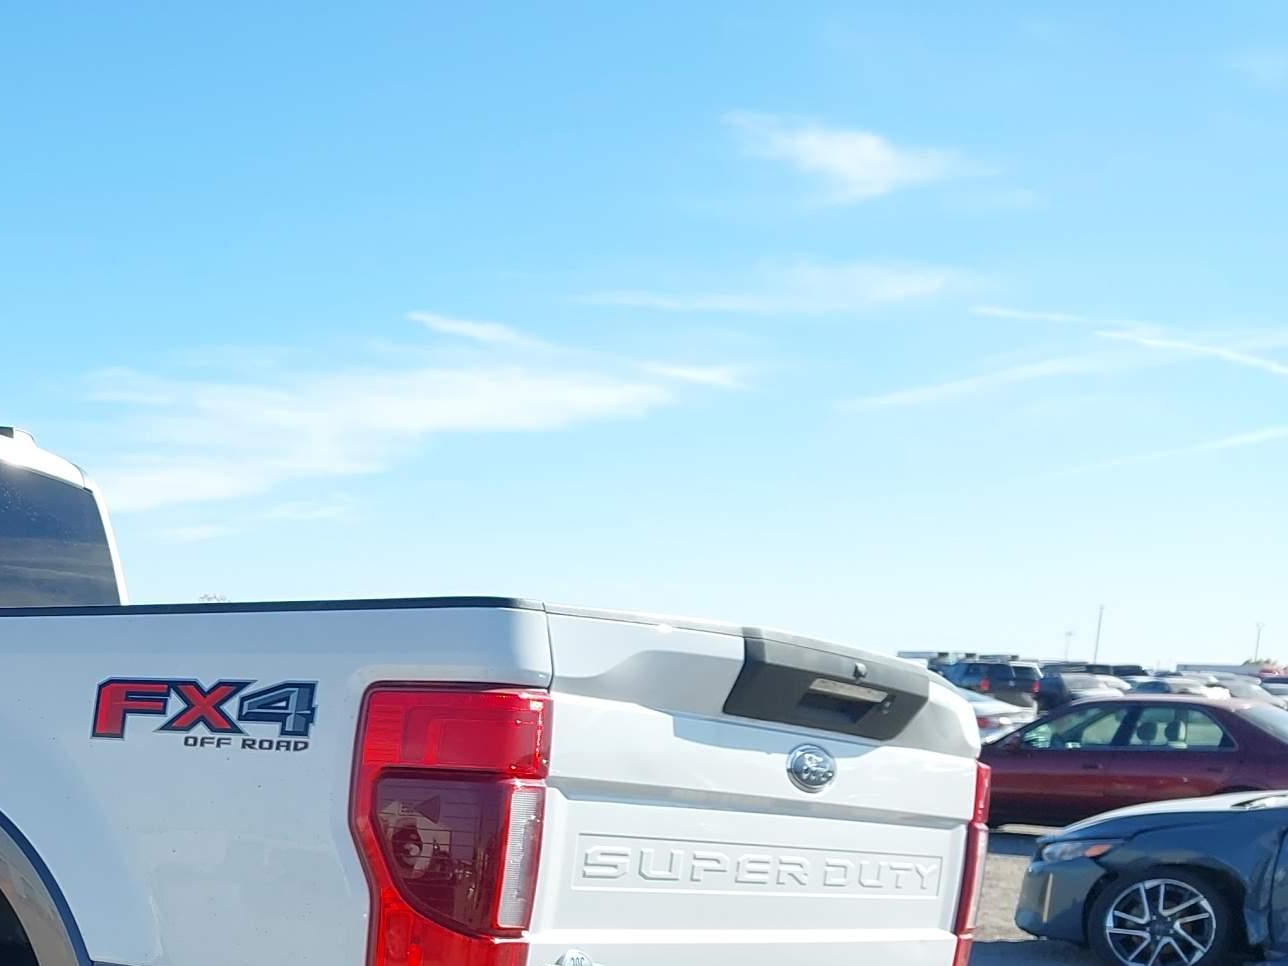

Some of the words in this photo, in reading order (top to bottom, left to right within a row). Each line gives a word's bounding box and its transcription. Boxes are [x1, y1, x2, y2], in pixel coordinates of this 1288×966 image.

[90, 677, 319, 739] FX4
[184, 735, 232, 749] OFF
[241, 737, 310, 751] ROAD
[581, 845, 810, 887] SUPER
[823, 858, 938, 890] DUTY
